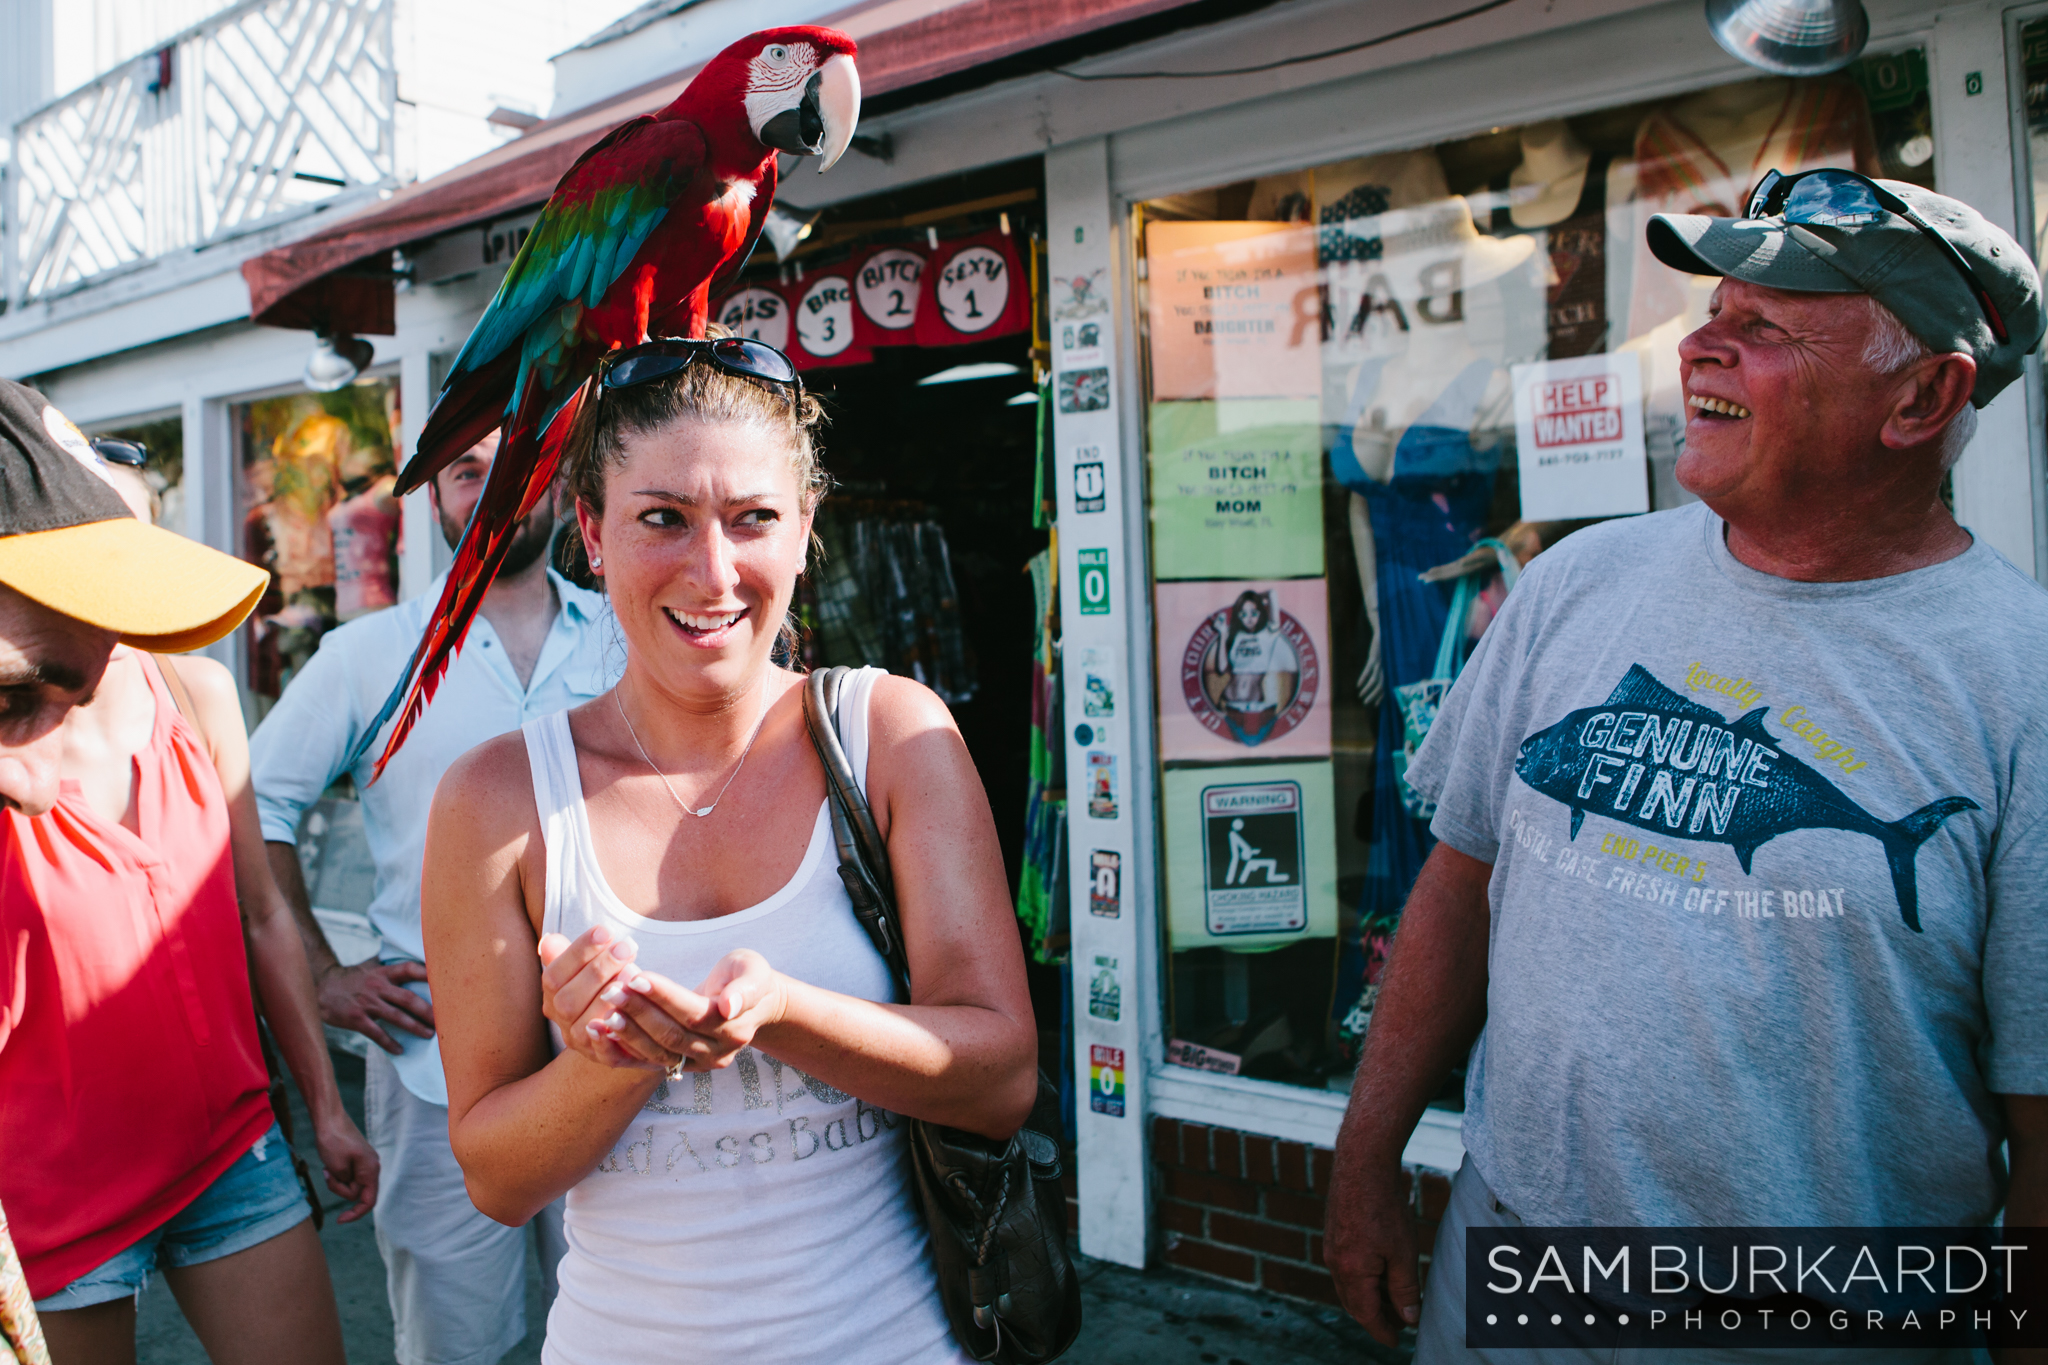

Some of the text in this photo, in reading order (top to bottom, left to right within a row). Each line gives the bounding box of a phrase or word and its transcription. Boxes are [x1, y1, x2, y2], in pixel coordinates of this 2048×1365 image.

[886, 289, 912, 317] 2
[965, 288, 983, 318] 1
[1204, 285, 1260, 299] BITCH
[822, 317, 835, 342] 3
[1194, 320, 1275, 334] DAUGHTER
[1544, 381, 1607, 411] HELP
[1536, 409, 1620, 444] WANTED
[1077, 446, 1100, 460] END
[1208, 466, 1266, 479] BITCH
[1216, 500, 1262, 513] MOM
[1085, 570, 1105, 603] 0
[1685, 661, 1868, 774] Locally Caught
[1579, 711, 1779, 788] GENUINE
[1216, 793, 1287, 809] WARNING
[1577, 752, 1741, 835] FINN
[1600, 832, 1708, 882] END PIER 5
[1605, 866, 1679, 907] FRESH
[1683, 886, 1729, 916] OFF
[1732, 888, 1775, 919] THE
[1783, 887, 1846, 919] BOAT
[1100, 1066, 1116, 1097] 0
